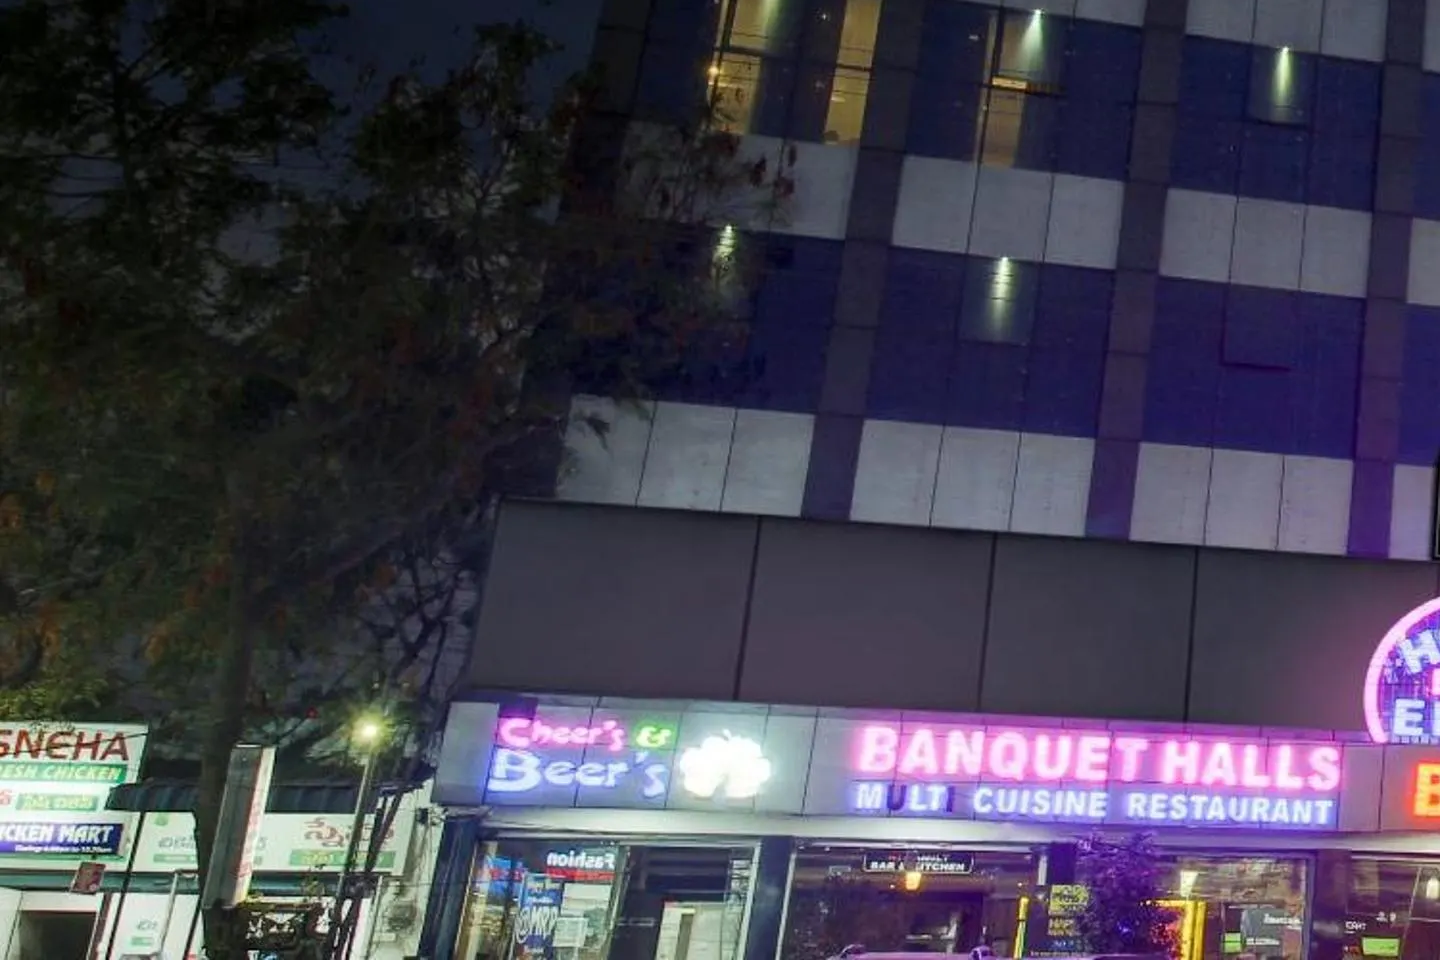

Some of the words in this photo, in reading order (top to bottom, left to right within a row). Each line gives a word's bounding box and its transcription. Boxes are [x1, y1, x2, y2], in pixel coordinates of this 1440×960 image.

[501, 718, 625, 751] Cheer's
[635, 726, 671, 748] &
[44, 764, 122, 780] CHICKEN
[487, 748, 669, 797] Beer's
[860, 726, 1148, 782] BANQUET
[1162, 740, 1341, 790] HALLS
[856, 783, 953, 813] MULTI
[973, 786, 1107, 817] CUISINE
[1128, 792, 1335, 824] RESTAURANT
[57, 825, 114, 844] MART
